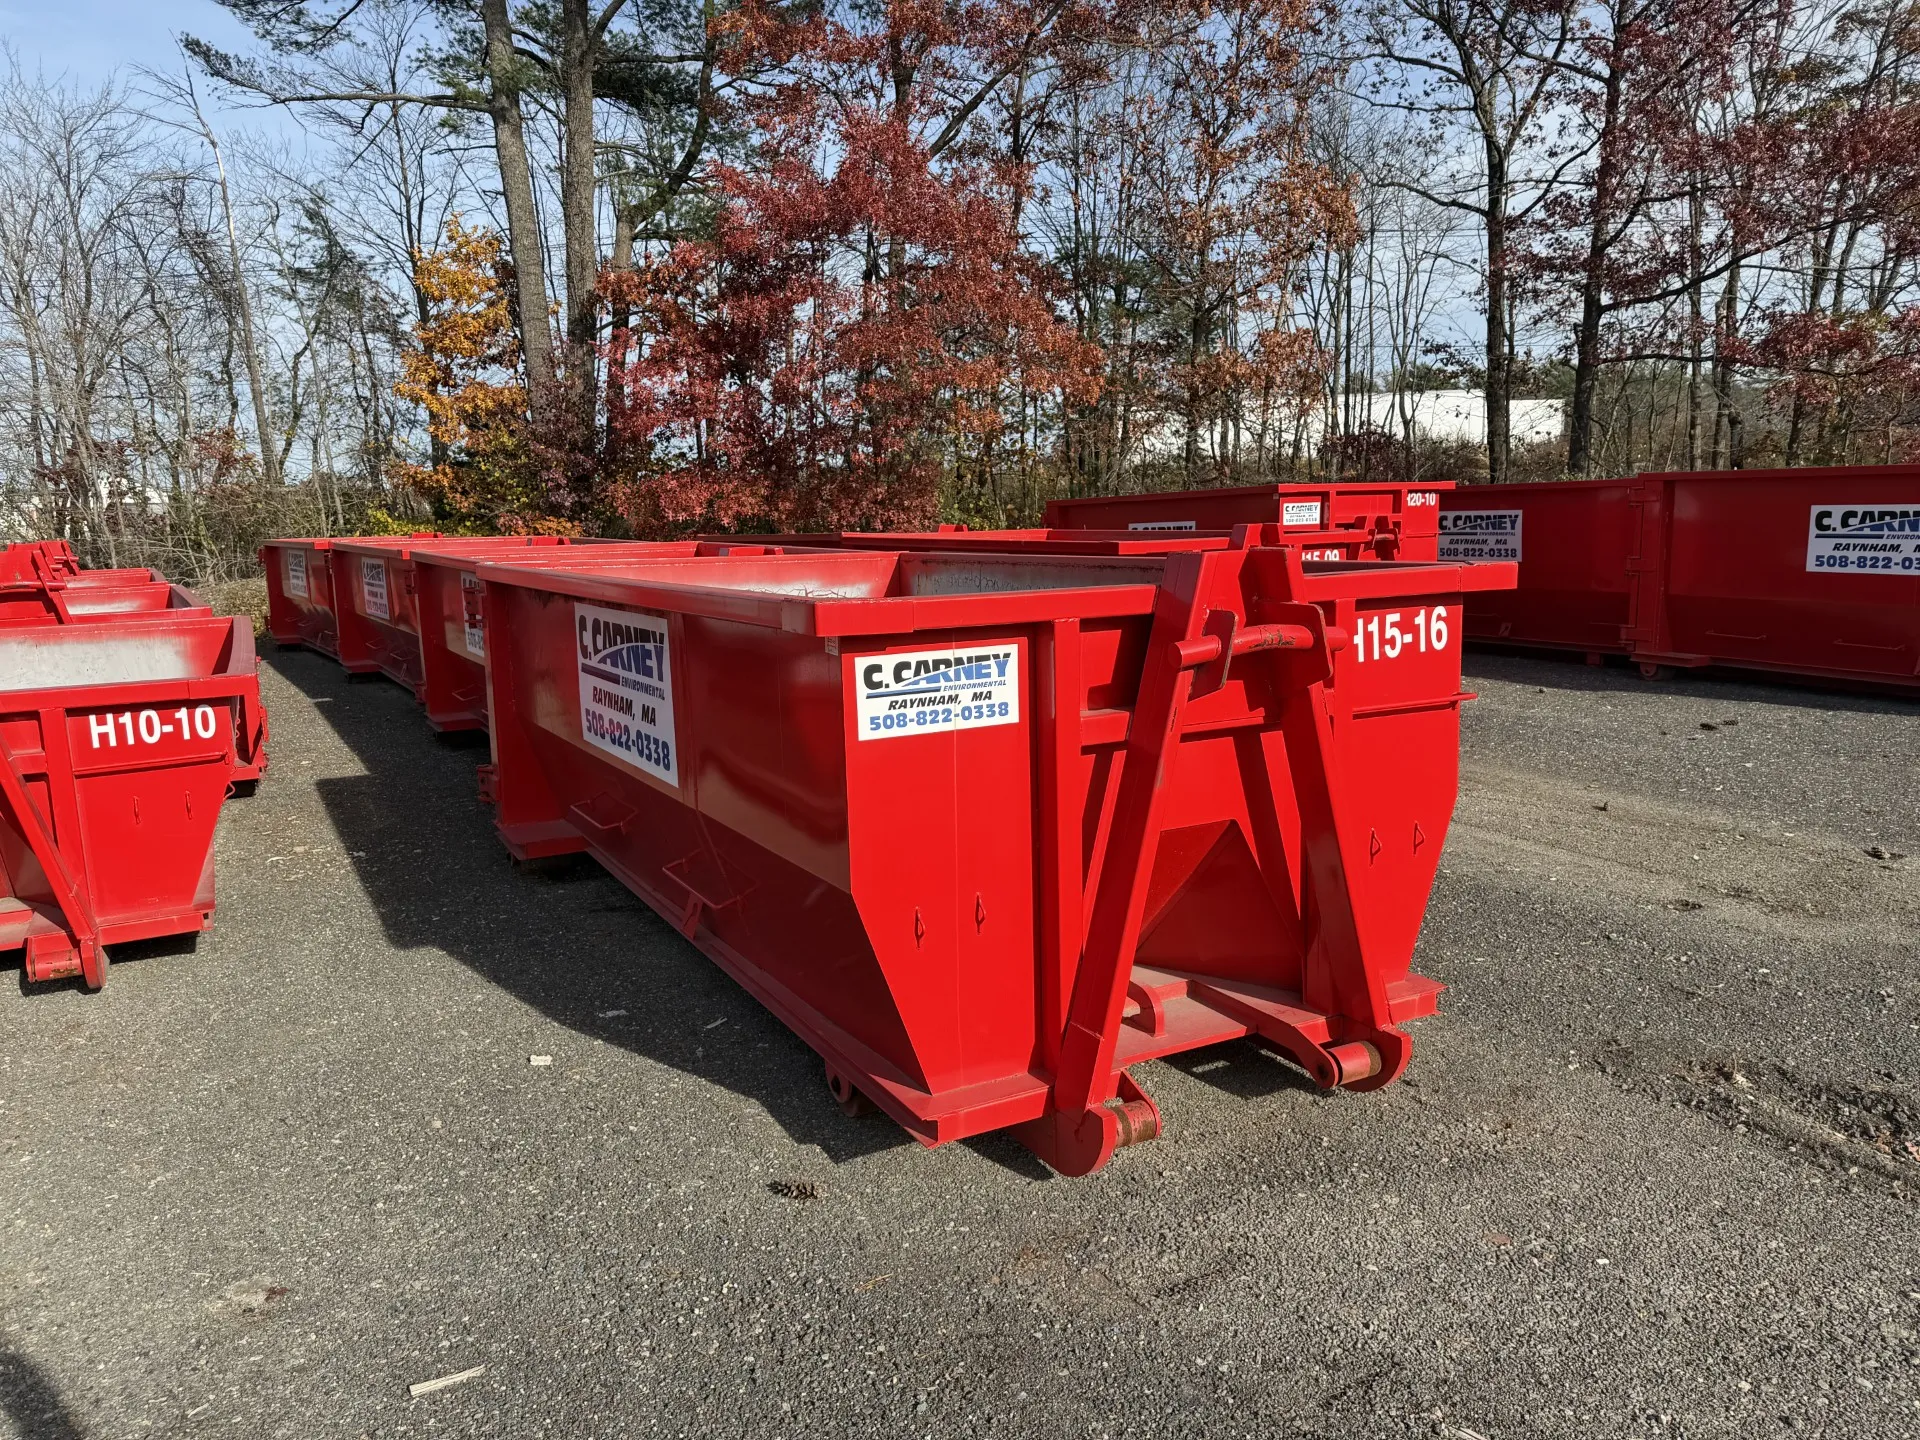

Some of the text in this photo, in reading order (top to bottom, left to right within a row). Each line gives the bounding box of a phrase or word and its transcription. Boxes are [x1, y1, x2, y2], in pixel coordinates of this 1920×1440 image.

[1452, 514, 1519, 531] CARNEY
[1439, 548, 1518, 558] 508-822-0338
[1832, 542, 1904, 554] RAYNHAM,
[591, 617, 665, 683] CARNEY
[892, 652, 1012, 688] CARNEY
[621, 676, 665, 701] ENVIRONMENTAL
[943, 679, 1007, 693] ENVIRONMENTAL
[592, 685, 656, 727] RAYNHAM, MA
[888, 690, 992, 711] RAYNHAM, MA
[88, 704, 217, 749] H10-10
[869, 701, 1010, 731] 508-822-0338
[584, 707, 671, 772] 508-822-0338
